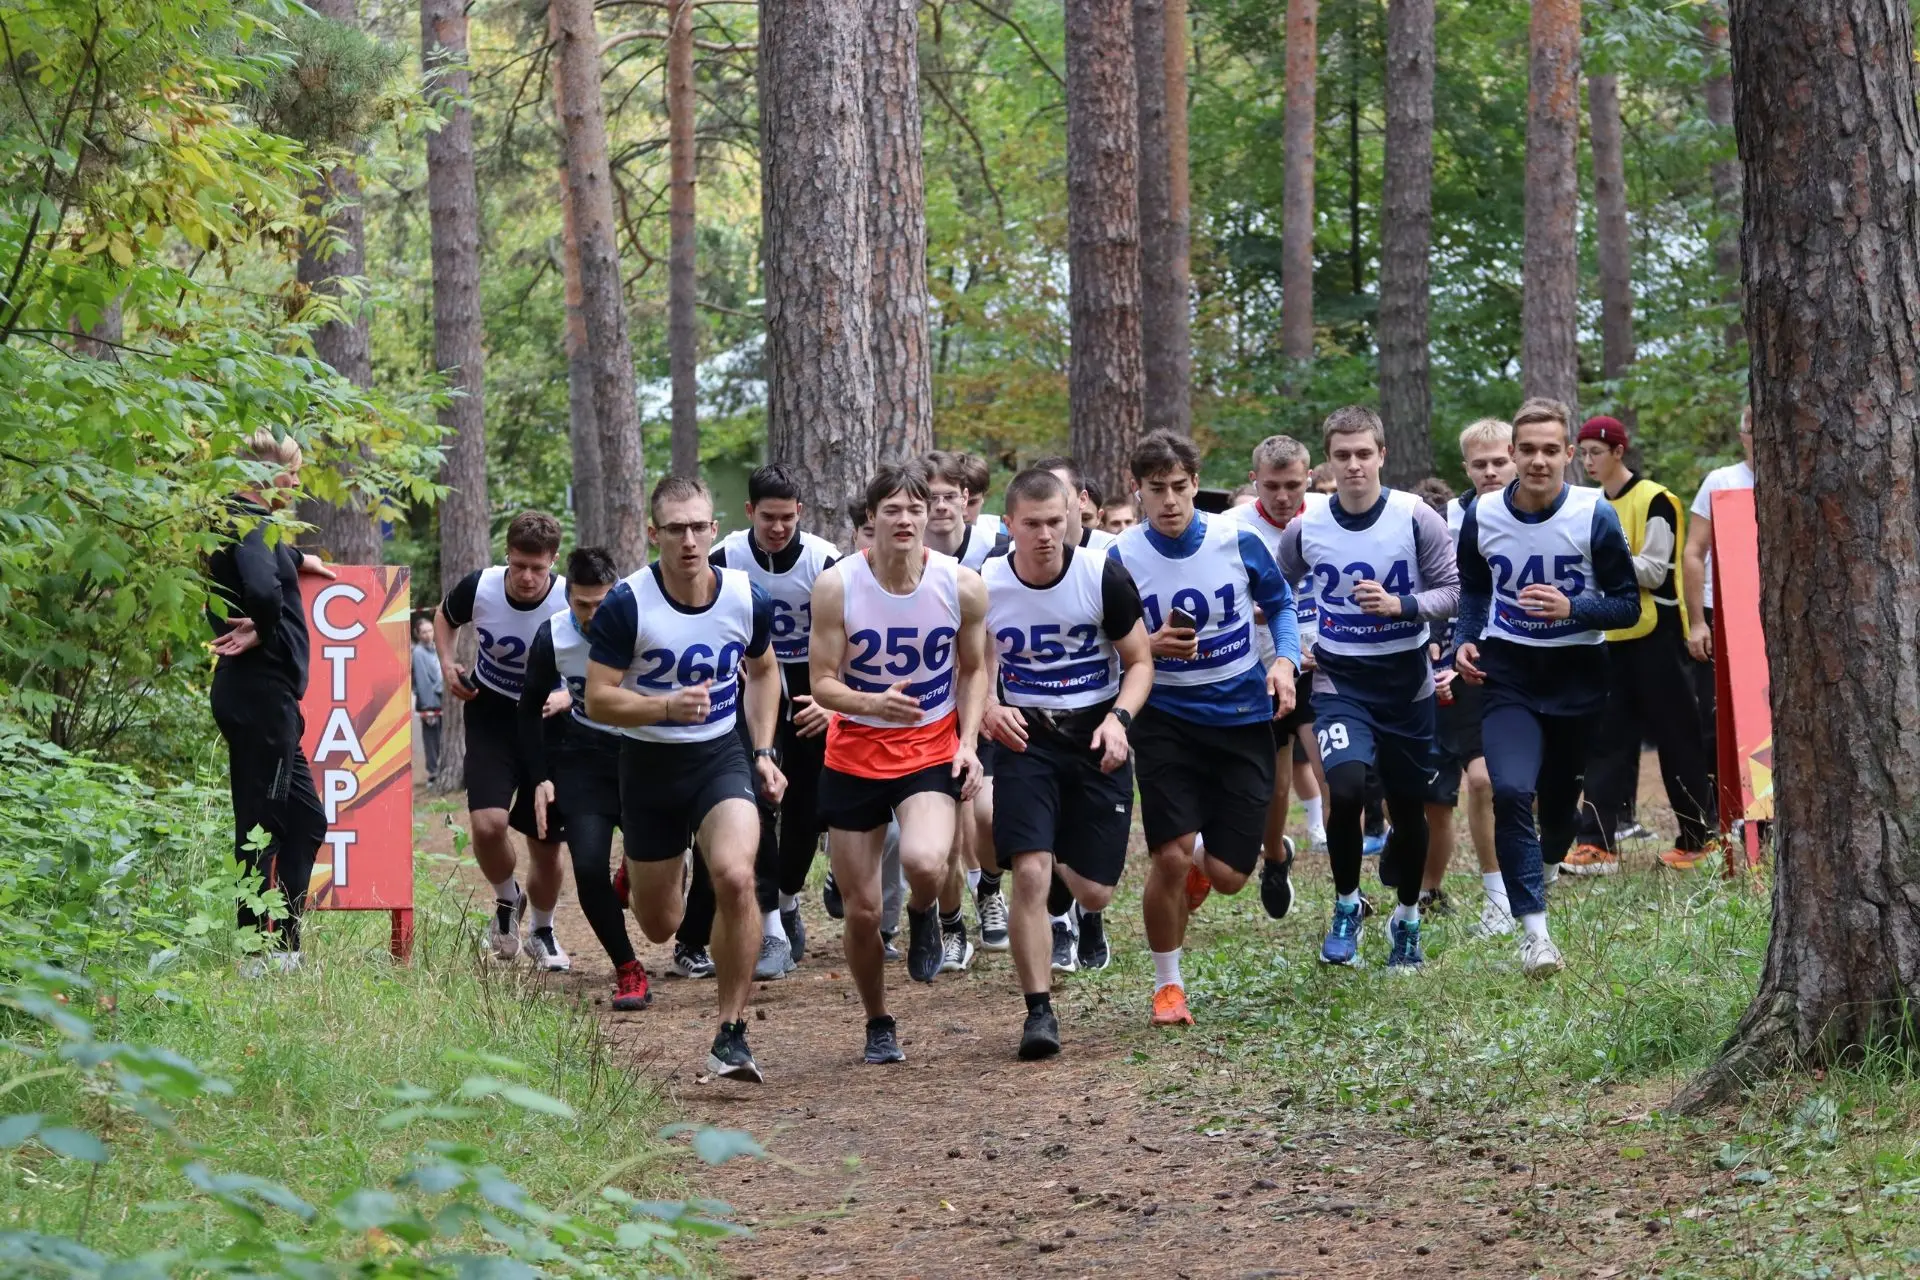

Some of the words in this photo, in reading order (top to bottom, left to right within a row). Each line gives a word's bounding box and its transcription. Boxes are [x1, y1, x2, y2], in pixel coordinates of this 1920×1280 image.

[1313, 560, 1415, 606] 234
[1488, 555, 1586, 600] 245
[1143, 583, 1241, 635] 191
[637, 641, 746, 690] 260
[849, 627, 956, 677] 256
[996, 624, 1101, 665] 252
[312, 583, 369, 887] СТАРТ
[1317, 722, 1350, 762] 29
